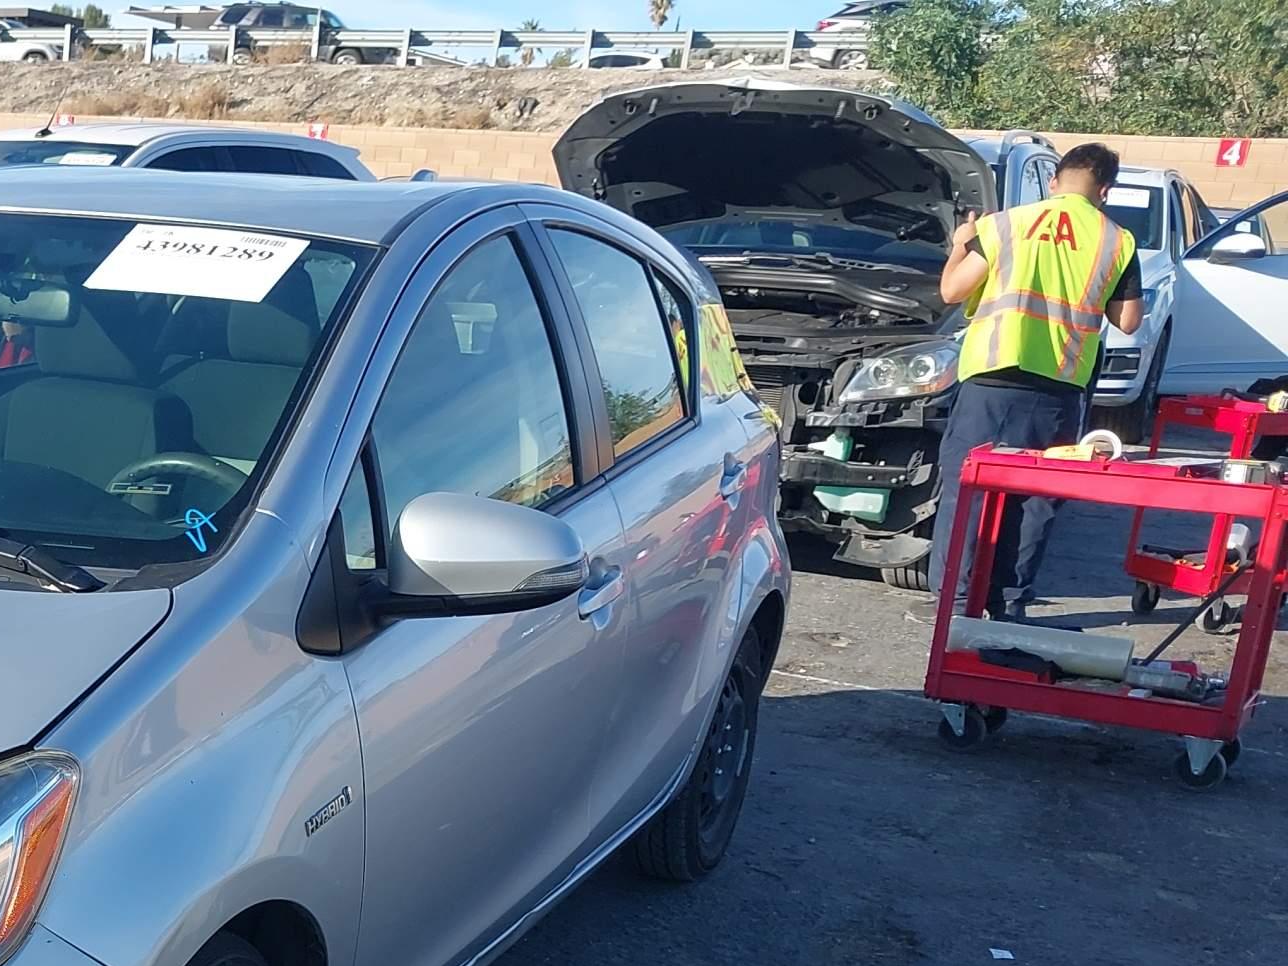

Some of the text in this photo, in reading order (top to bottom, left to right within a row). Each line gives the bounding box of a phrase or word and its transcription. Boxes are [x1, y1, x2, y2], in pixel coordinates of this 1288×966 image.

[1222, 140, 1242, 165] 4
[136, 239, 275, 262] 43981289
[307, 795, 346, 834] HYBRID
